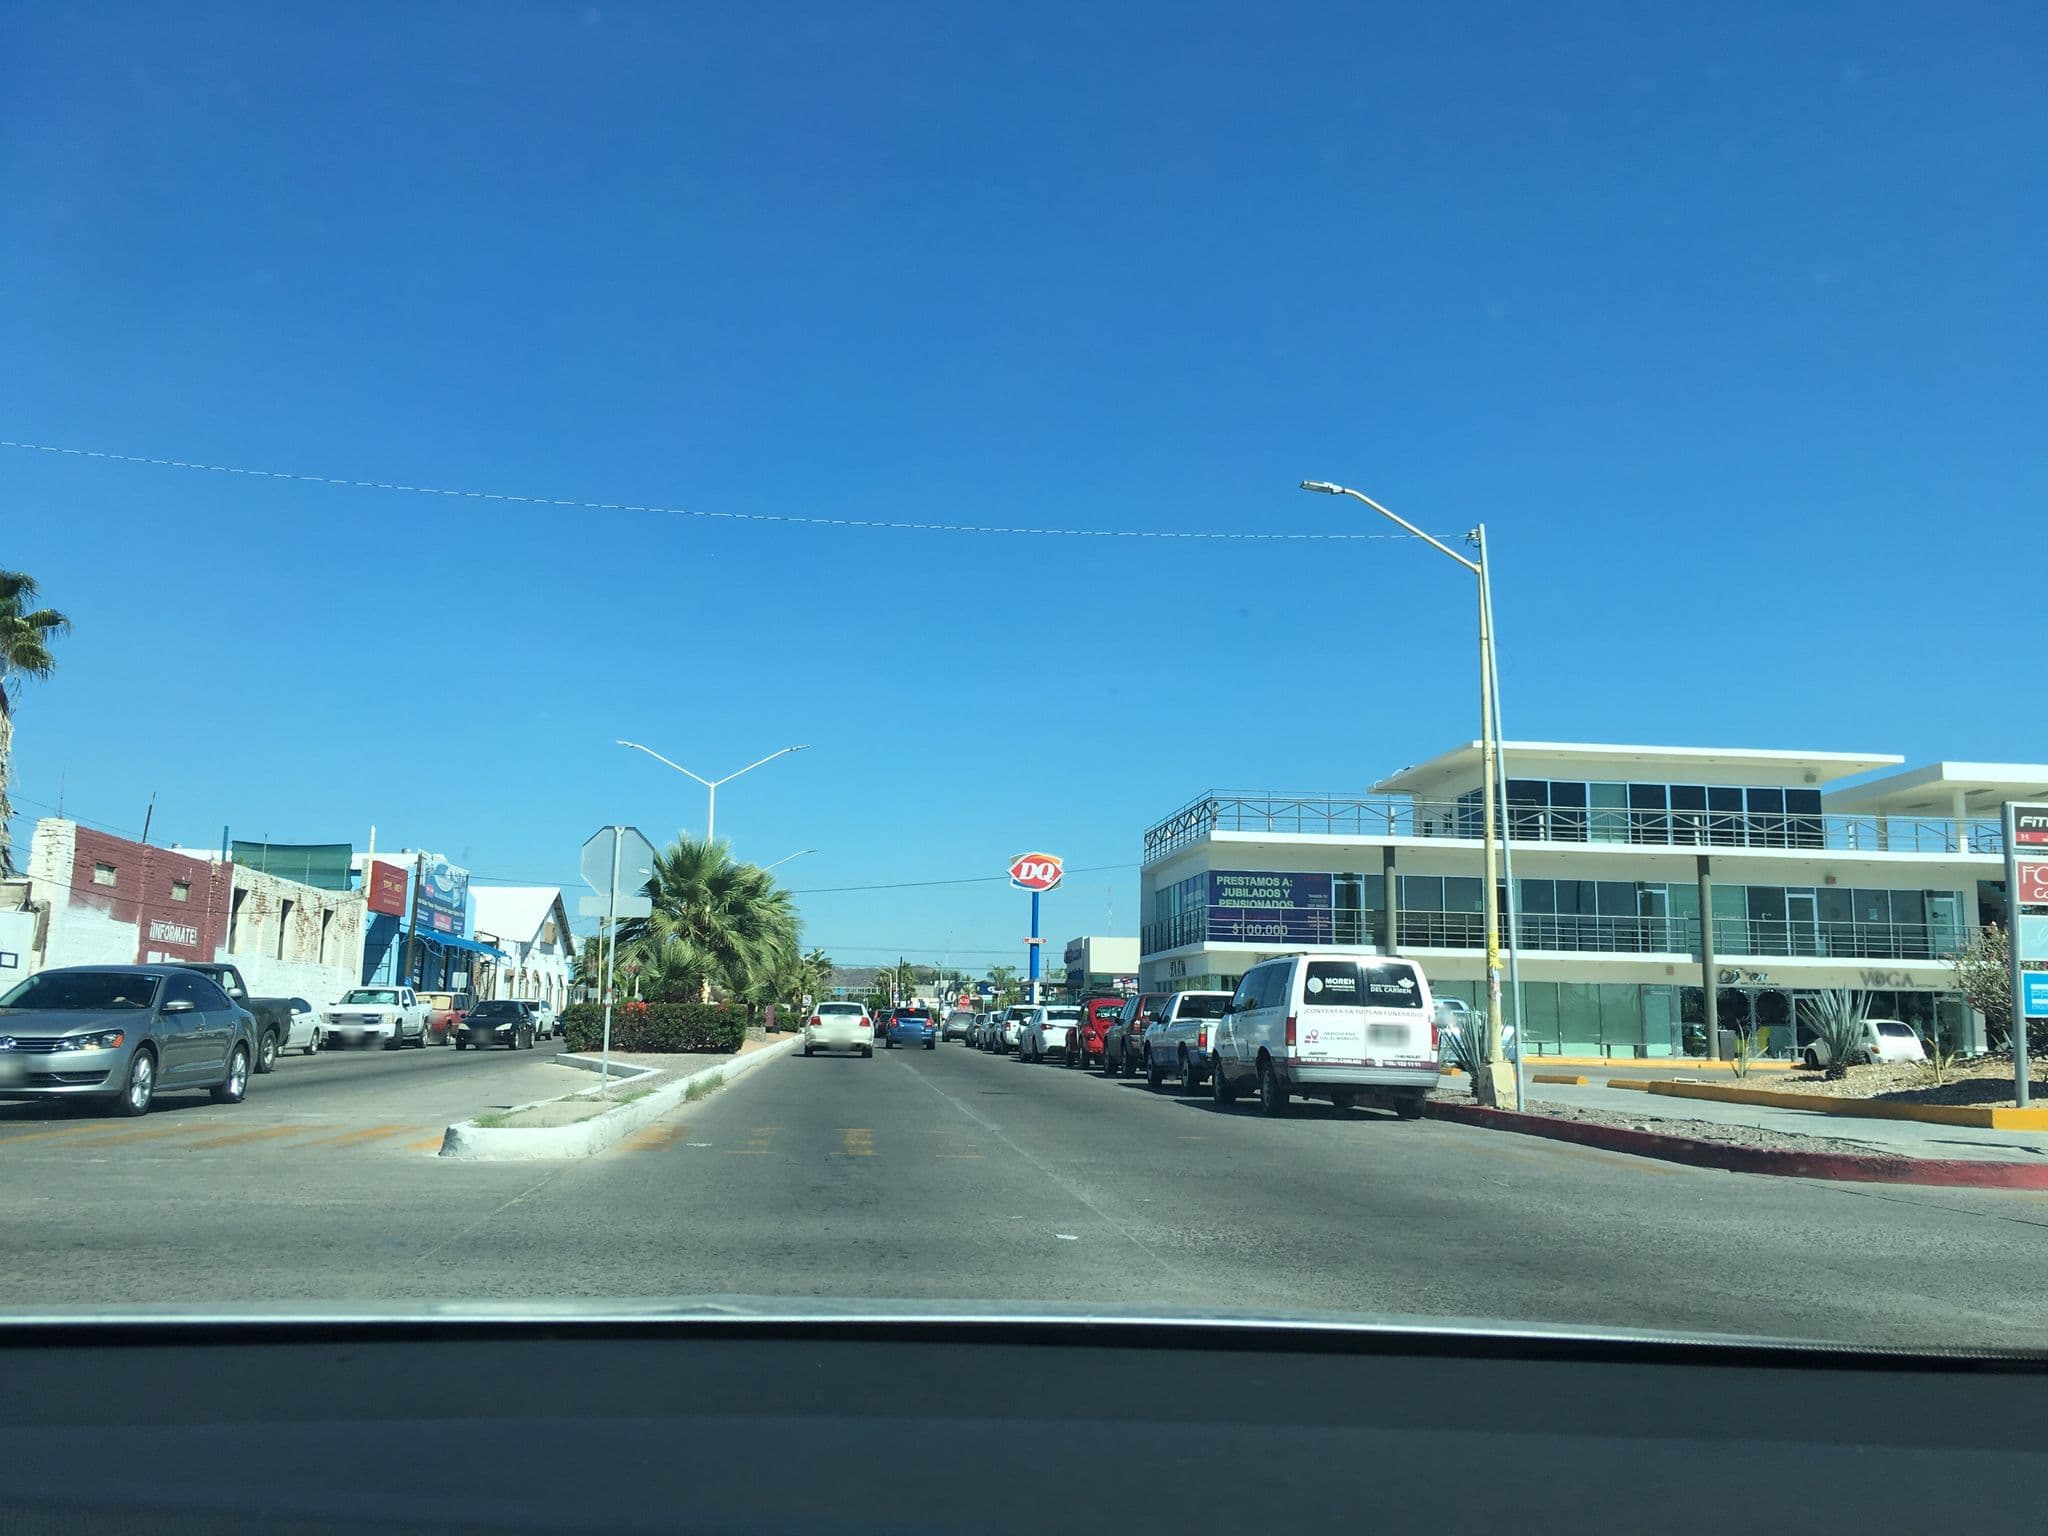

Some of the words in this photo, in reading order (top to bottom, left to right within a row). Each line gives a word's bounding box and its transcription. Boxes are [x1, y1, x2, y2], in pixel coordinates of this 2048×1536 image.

[1019, 862, 1055, 883] DQ
[1216, 876, 1280, 887] PRESTAMOS
[1281, 877, 1293, 887] A:
[1222, 888, 1281, 898] JUBILADOS
[1283, 889, 1290, 898] Y
[1219, 899, 1294, 909] PENSIONADOS
[1232, 923, 1288, 936] $00,000
[1325, 977, 1355, 985] MOREH
